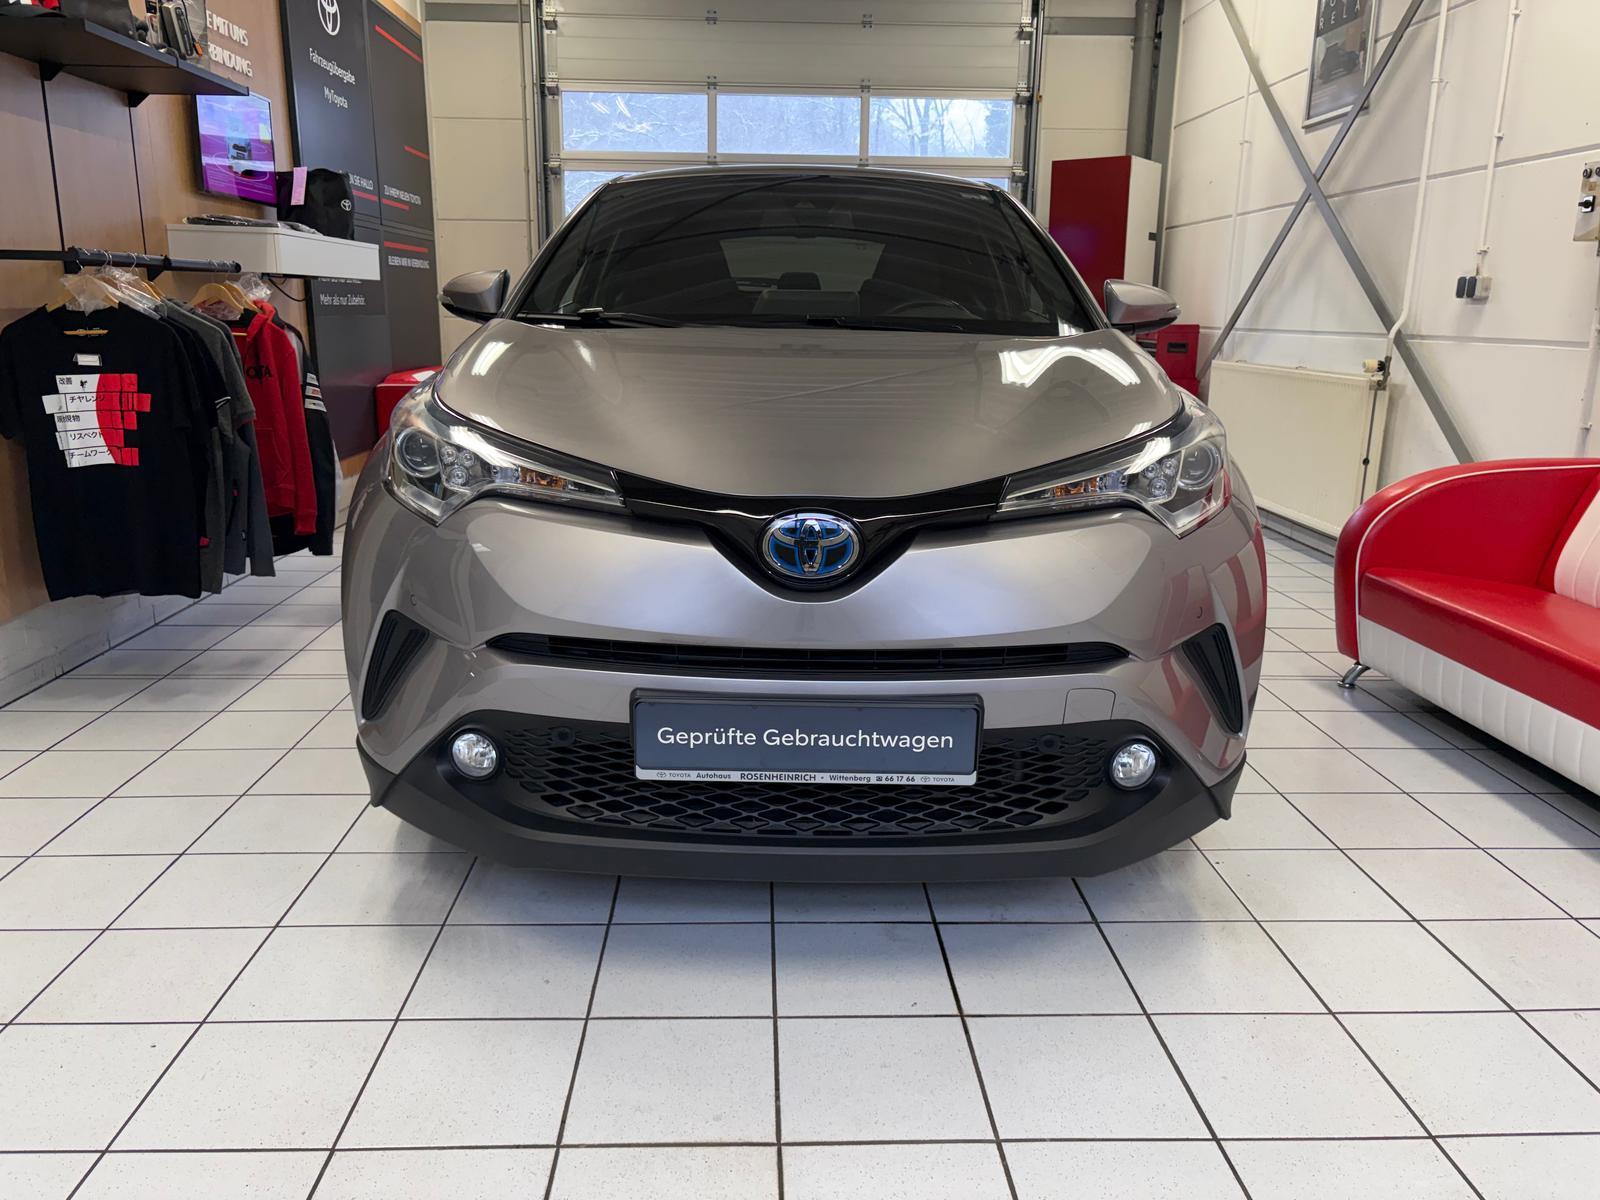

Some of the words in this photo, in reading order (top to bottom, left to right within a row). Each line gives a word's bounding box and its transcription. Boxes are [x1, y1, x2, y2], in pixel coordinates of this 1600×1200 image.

[212, 13, 229, 37] MIT
[229, 23, 249, 47] UNS
[309, 47, 356, 85] Fahrzeugübergabe
[324, 86, 348, 108] MyToyota
[58, 376, 73, 385] 改善
[657, 727, 757, 748] Geprüfte
[763, 728, 954, 752] Gebrauchtwagen
[740, 772, 816, 782] ROSENHEINRICH
[829, 773, 871, 783] Wittenberg
[905, 775, 916, 783] 66
